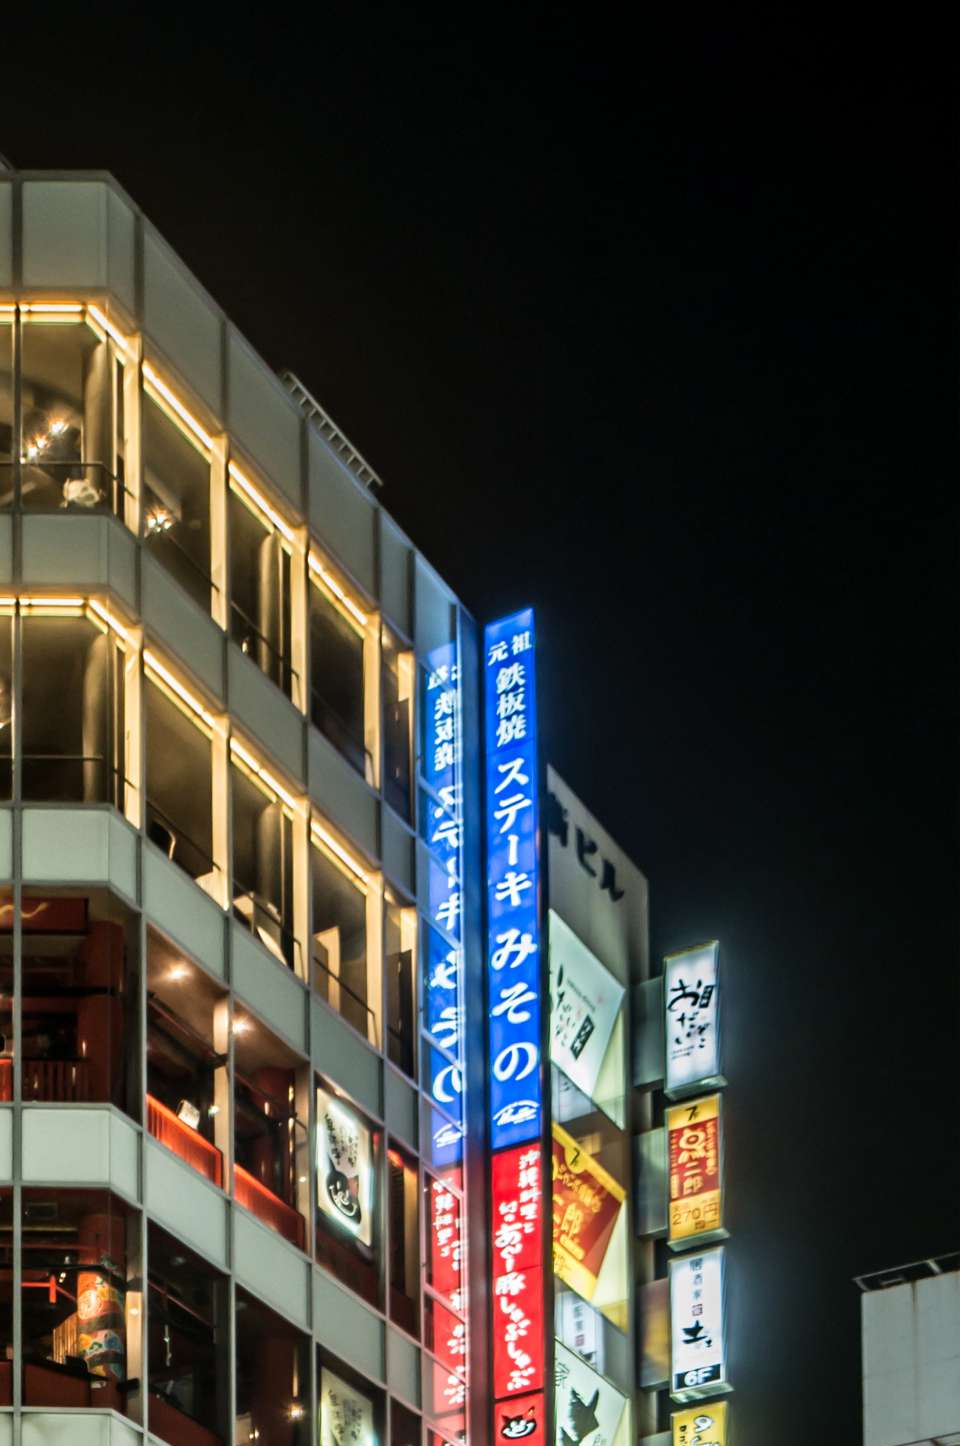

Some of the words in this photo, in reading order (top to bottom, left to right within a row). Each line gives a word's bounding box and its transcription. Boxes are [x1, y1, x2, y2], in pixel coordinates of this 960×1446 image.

[488, 631, 532, 666] 元祖
[496, 663, 526, 747] 鉄板焼
[493, 758, 532, 906] ステーキ
[491, 928, 538, 1082] みその
[683, 1367, 714, 1388] 6F
